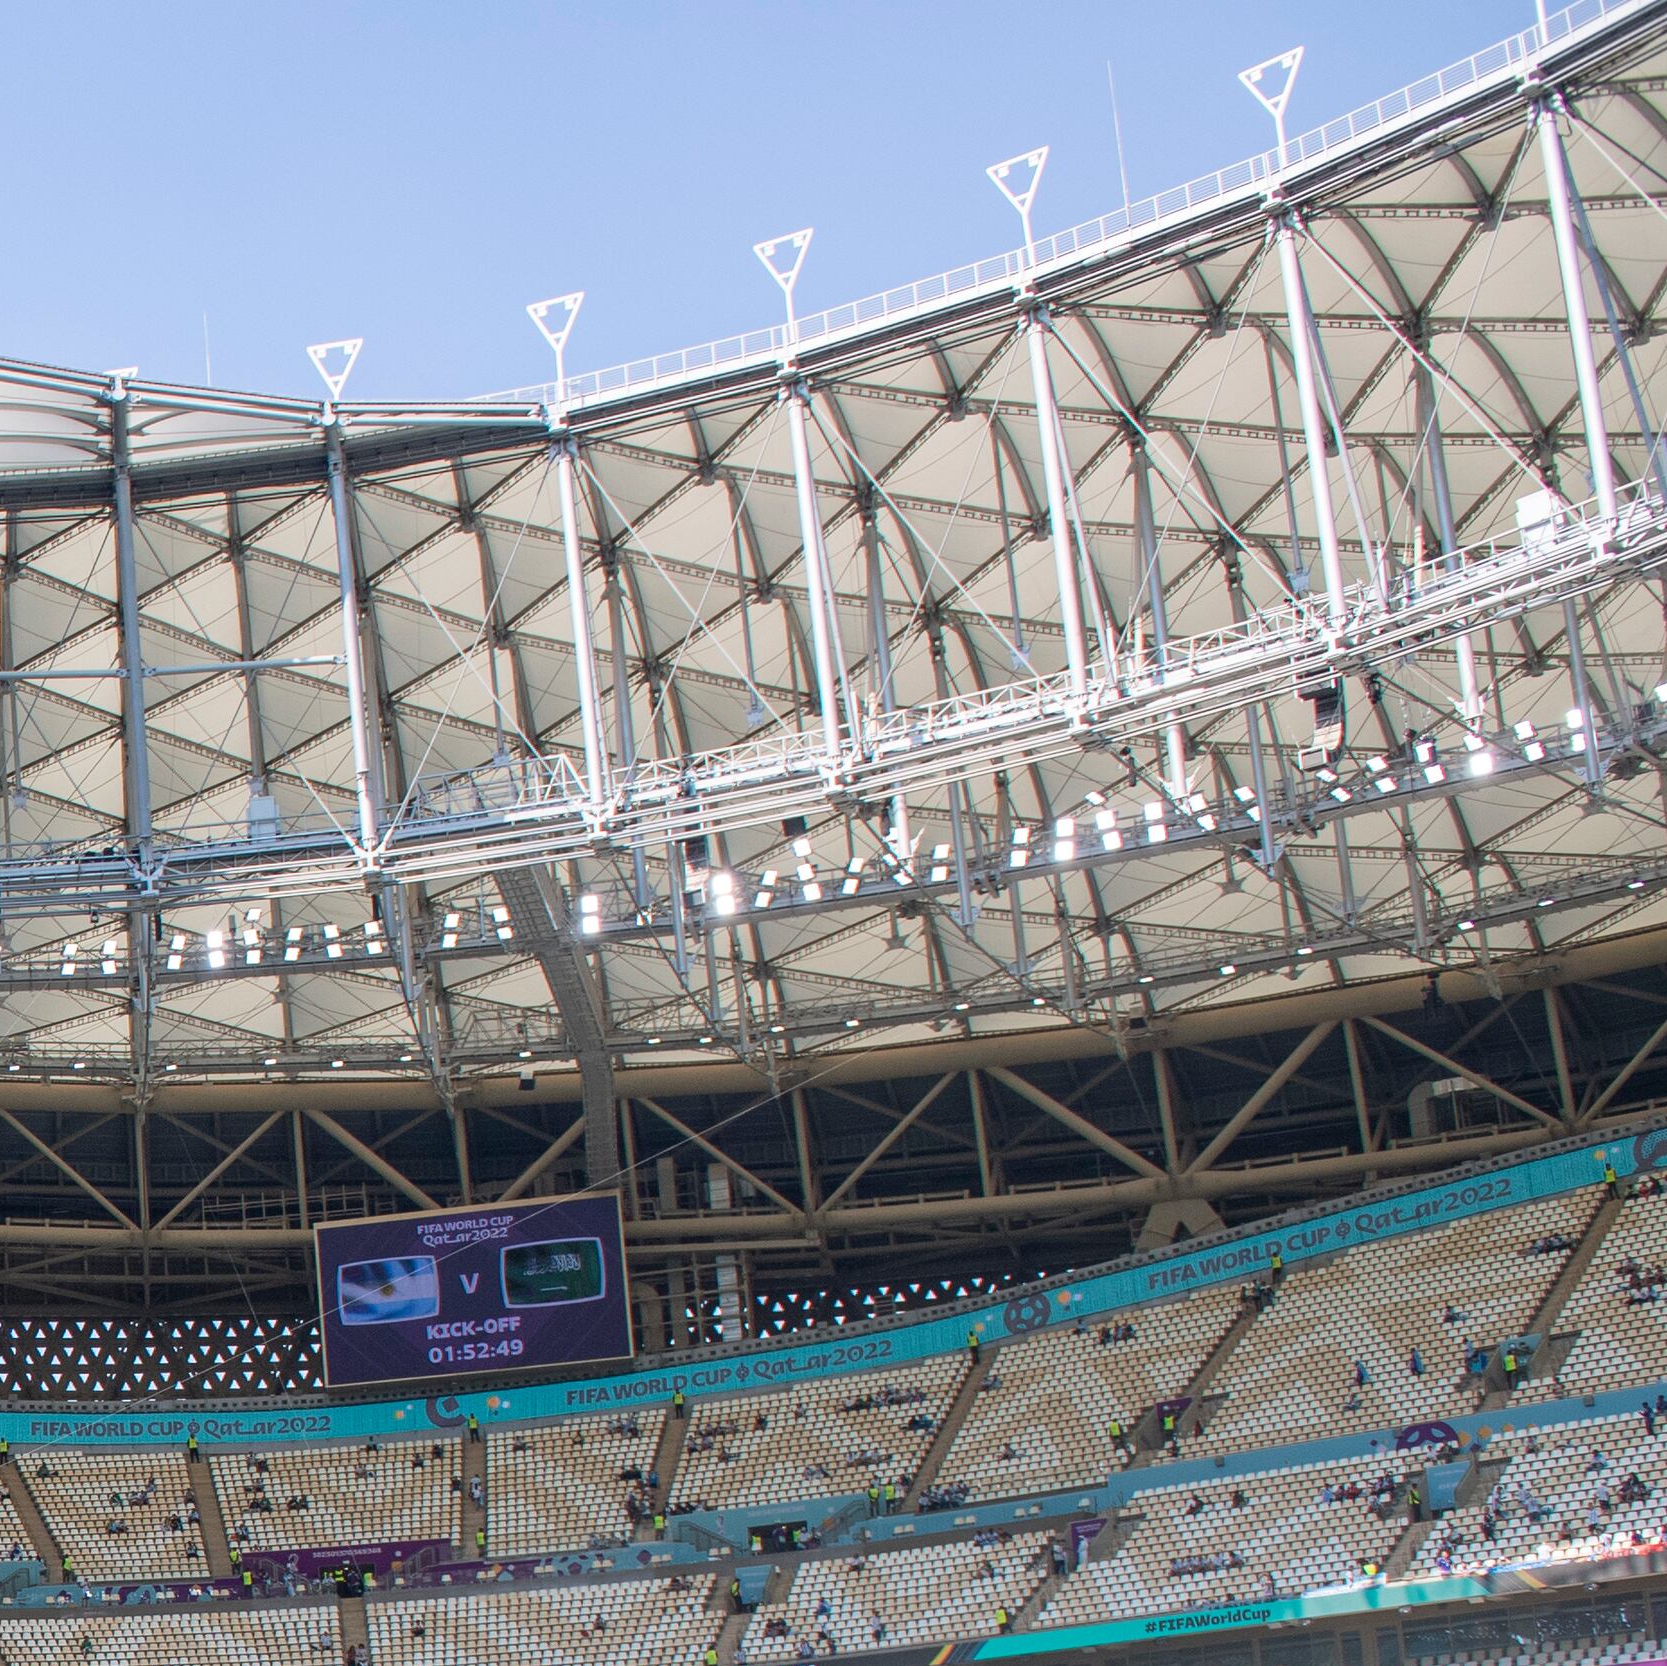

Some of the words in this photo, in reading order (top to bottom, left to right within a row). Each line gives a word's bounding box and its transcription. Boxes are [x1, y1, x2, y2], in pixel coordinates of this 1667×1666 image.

[417, 1222, 443, 1235] FIFA
[444, 1218, 487, 1233] WORLD
[490, 1215, 514, 1226] CUP
[1148, 1264, 1197, 1291] FIFA
[1198, 1241, 1283, 1281] WORLD
[1286, 1226, 1332, 1252] CUP
[459, 1272, 479, 1294] V
[426, 1316, 521, 1340] KICK-OFF
[428, 1339, 524, 1363] 01:52:49
[566, 1387, 611, 1406] FIFA
[612, 1377, 690, 1402] WORLD
[691, 1367, 733, 1390] CUP
[31, 1420, 72, 1438] FIFA
[72, 1421, 145, 1438] WORLD
[147, 1420, 184, 1437] CUP
[1144, 1607, 1272, 1633] #FIFAWorldCup
